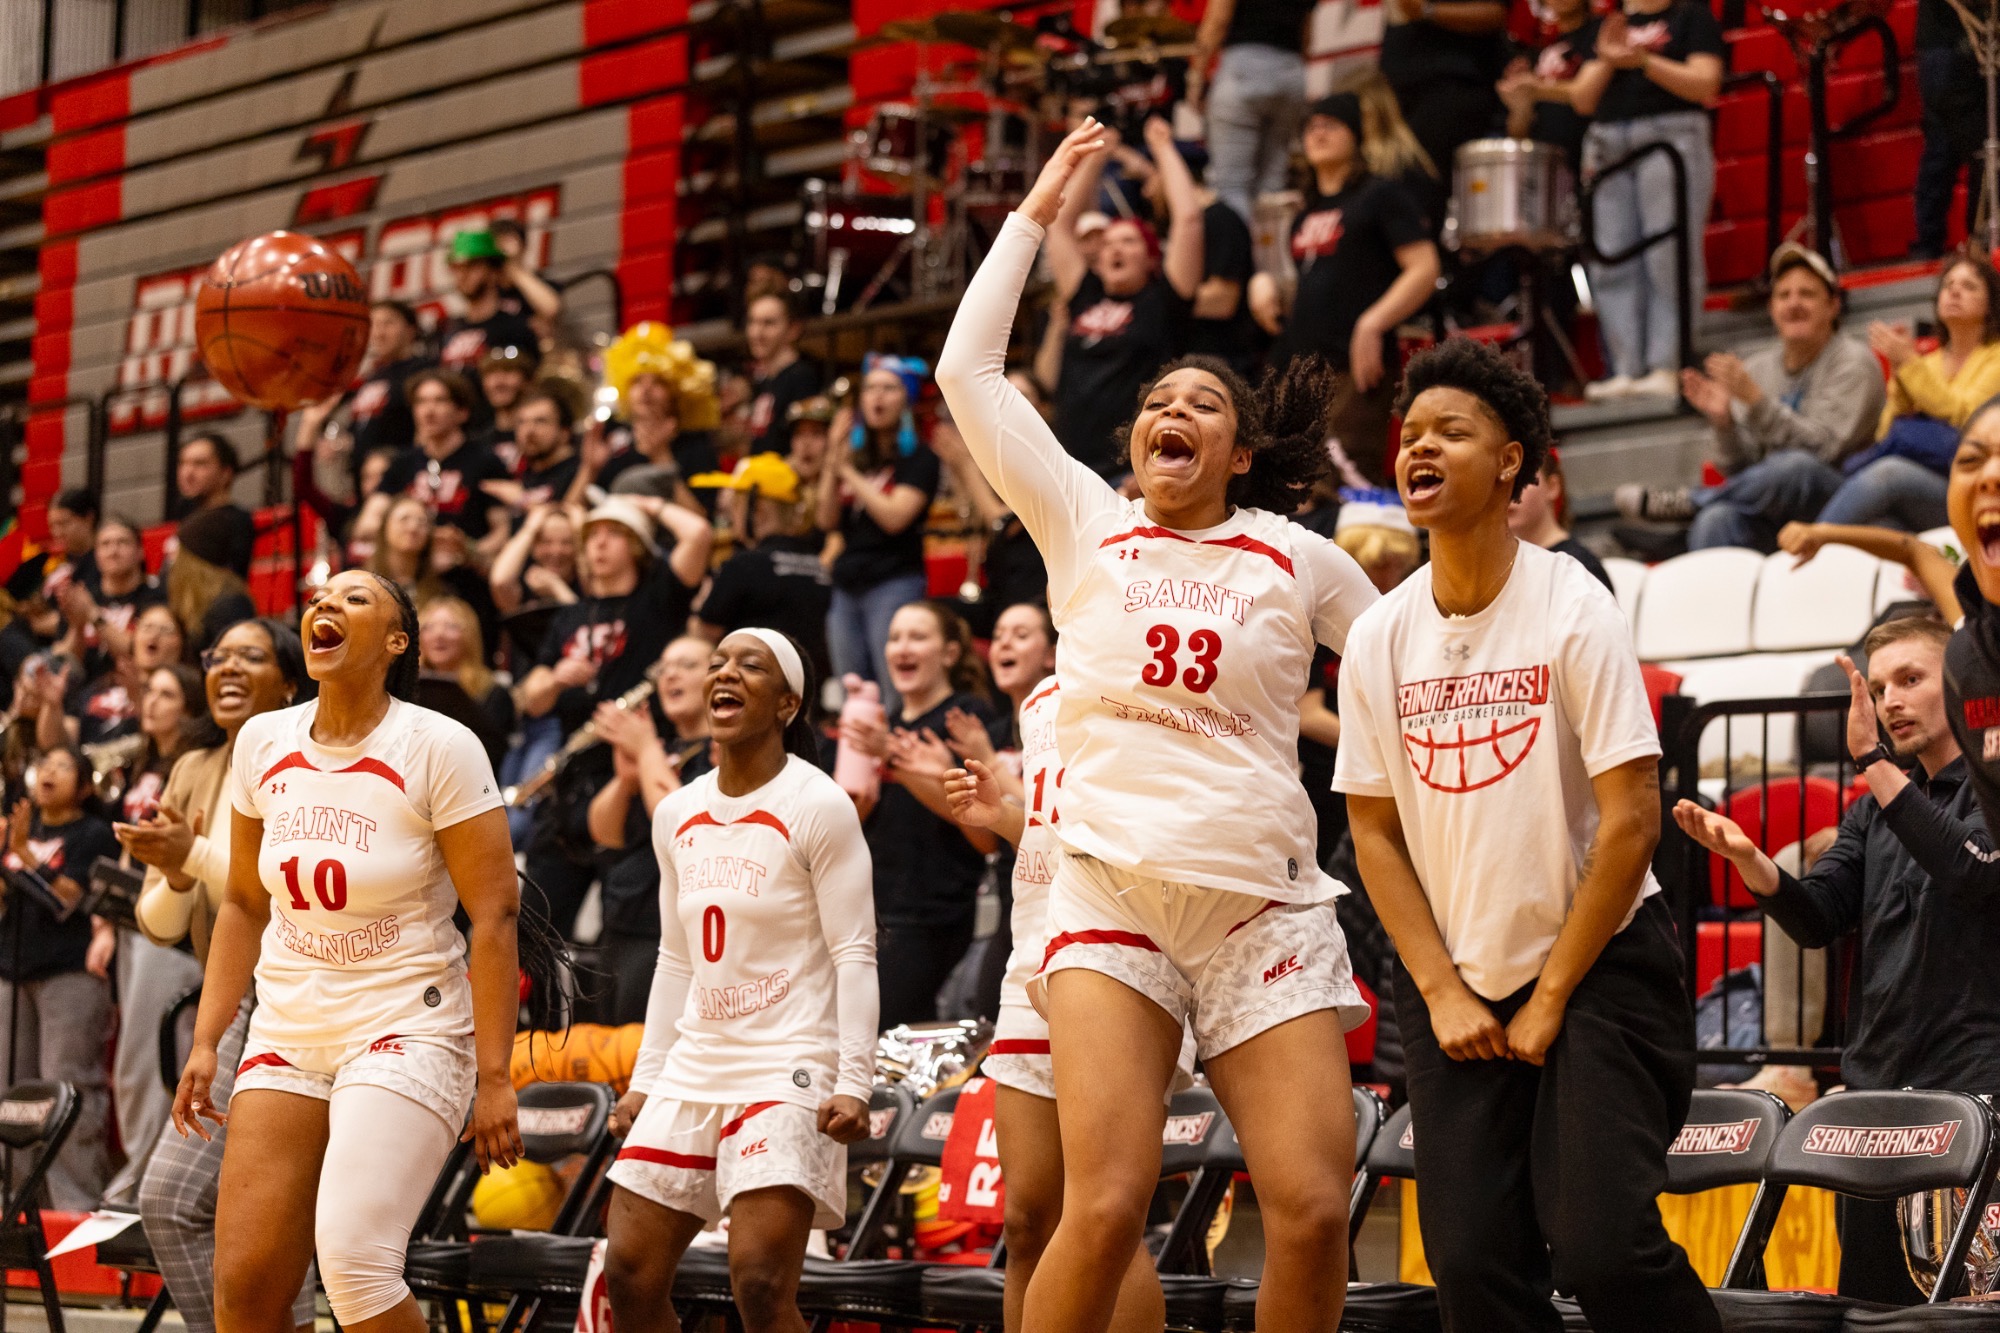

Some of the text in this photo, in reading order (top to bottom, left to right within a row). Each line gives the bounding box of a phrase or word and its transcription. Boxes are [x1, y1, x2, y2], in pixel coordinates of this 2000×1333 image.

[1125, 579, 1254, 626] SAINT
[1142, 624, 1222, 693] 33
[1398, 680, 1440, 718] AINT
[1407, 704, 1527, 731] WOMEN'S BASKETBALL
[269, 806, 377, 853] SAINT
[280, 856, 347, 911] 10
[680, 856, 767, 899] SAINT
[703, 905, 726, 963] 0
[1263, 955, 1298, 984] NEC
